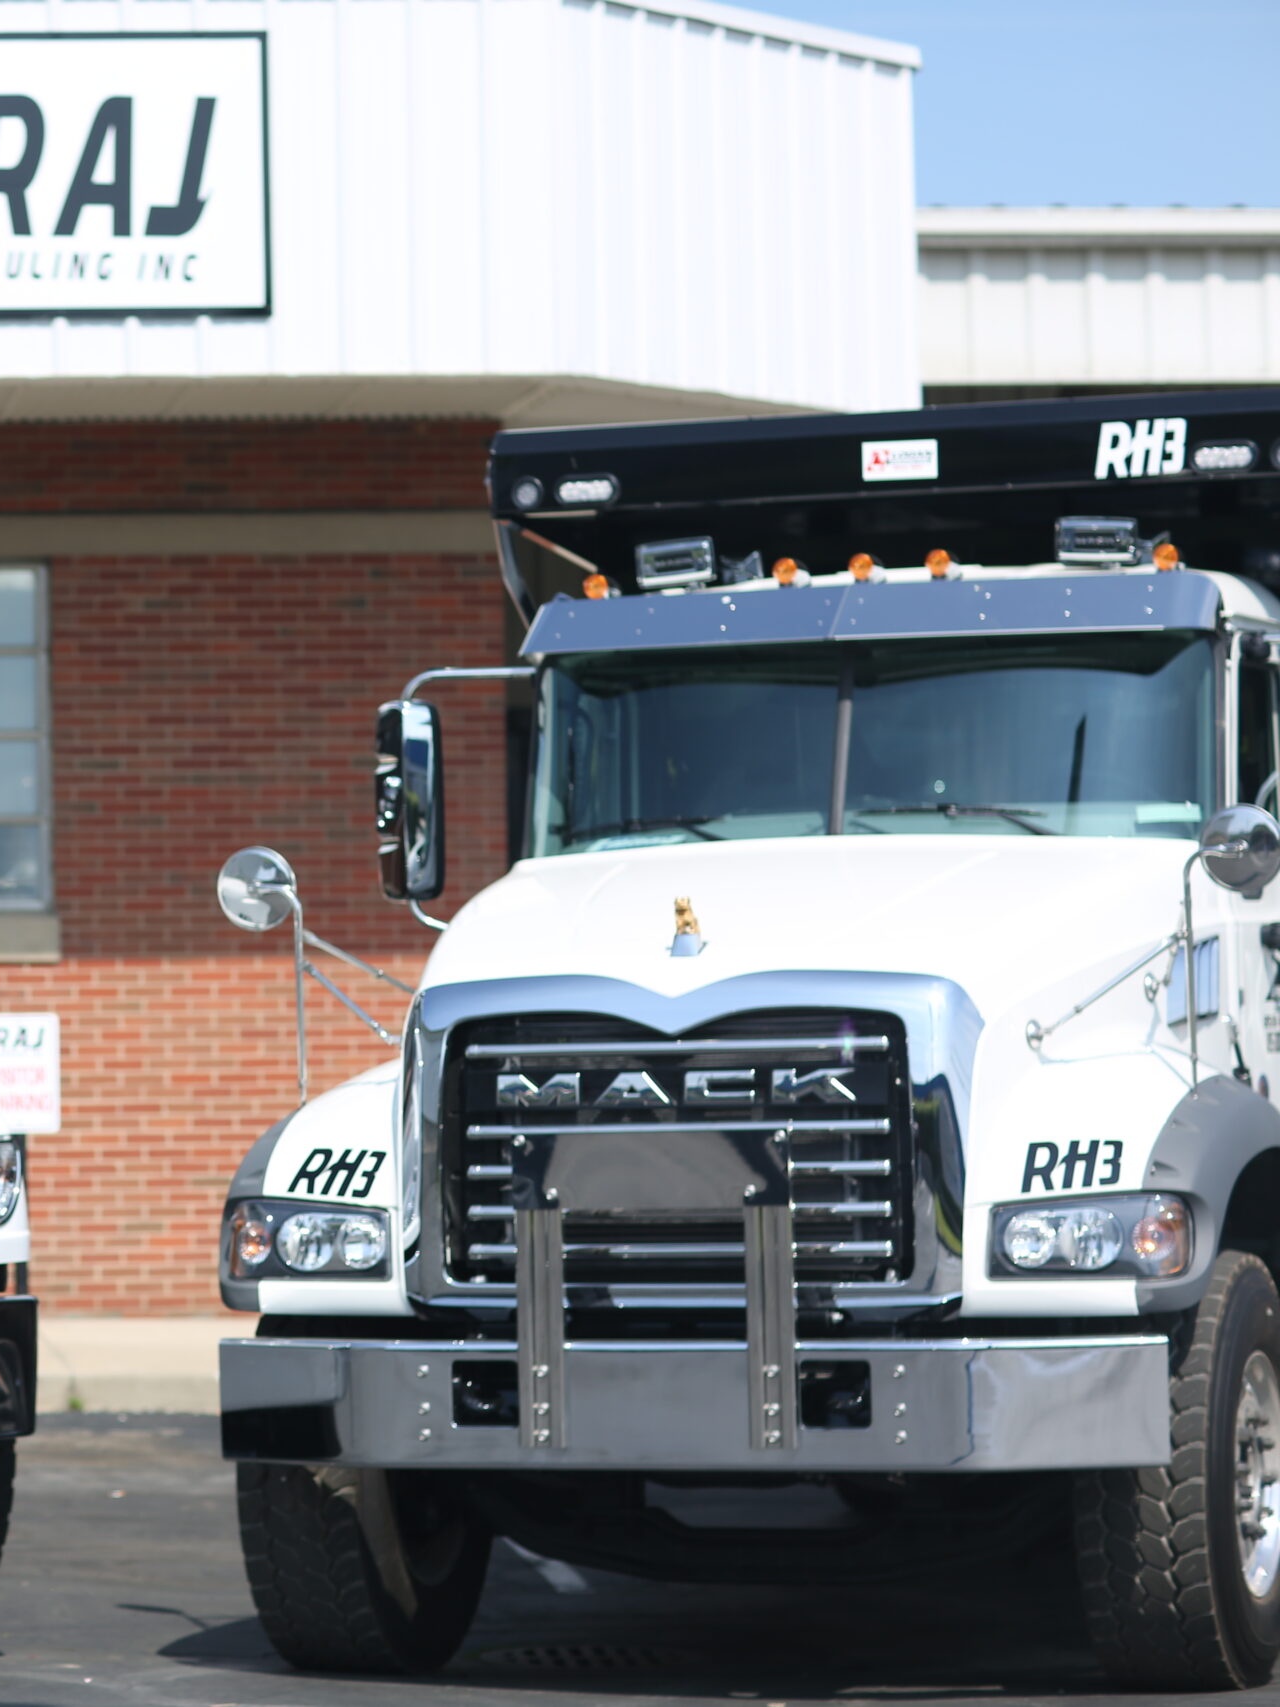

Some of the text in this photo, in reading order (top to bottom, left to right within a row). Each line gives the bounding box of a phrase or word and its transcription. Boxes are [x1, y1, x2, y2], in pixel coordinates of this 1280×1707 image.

[136, 253, 199, 283] INC
[1094, 417, 1187, 480] RH3
[496, 1067, 858, 1106] MACK
[288, 1147, 387, 1199] RH3
[1022, 1139, 1125, 1194] RH3
